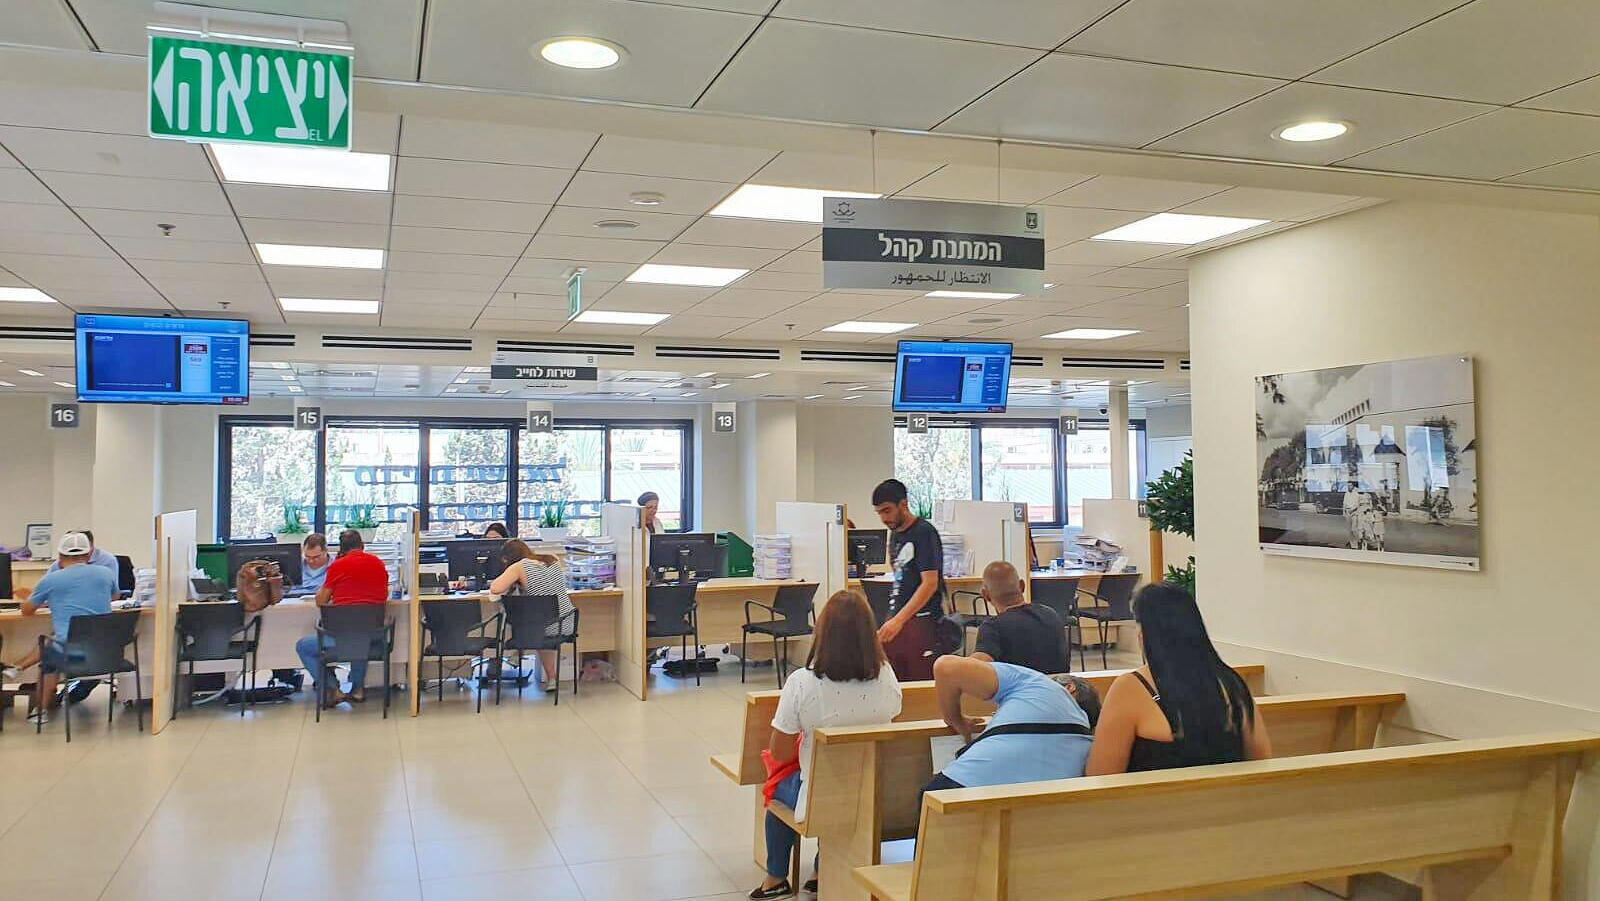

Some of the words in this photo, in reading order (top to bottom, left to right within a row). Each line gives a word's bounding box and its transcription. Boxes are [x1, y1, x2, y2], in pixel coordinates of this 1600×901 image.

[178, 47, 325, 140] יציאה
[309, 129, 324, 142] EL
[878, 232, 924, 263] קהל
[930, 238, 1002, 262] המתנת
[948, 269, 991, 286] الانتظار
[516, 366, 544, 377] לחייב
[546, 368, 576, 378] שירות
[54, 409, 75, 422] 16
[299, 412, 317, 424] 15
[532, 415, 549, 427] 14
[718, 415, 732, 427] 13
[912, 417, 926, 428] 12
[1065, 419, 1075, 430] 11
[1014, 507, 1024, 518] 12
